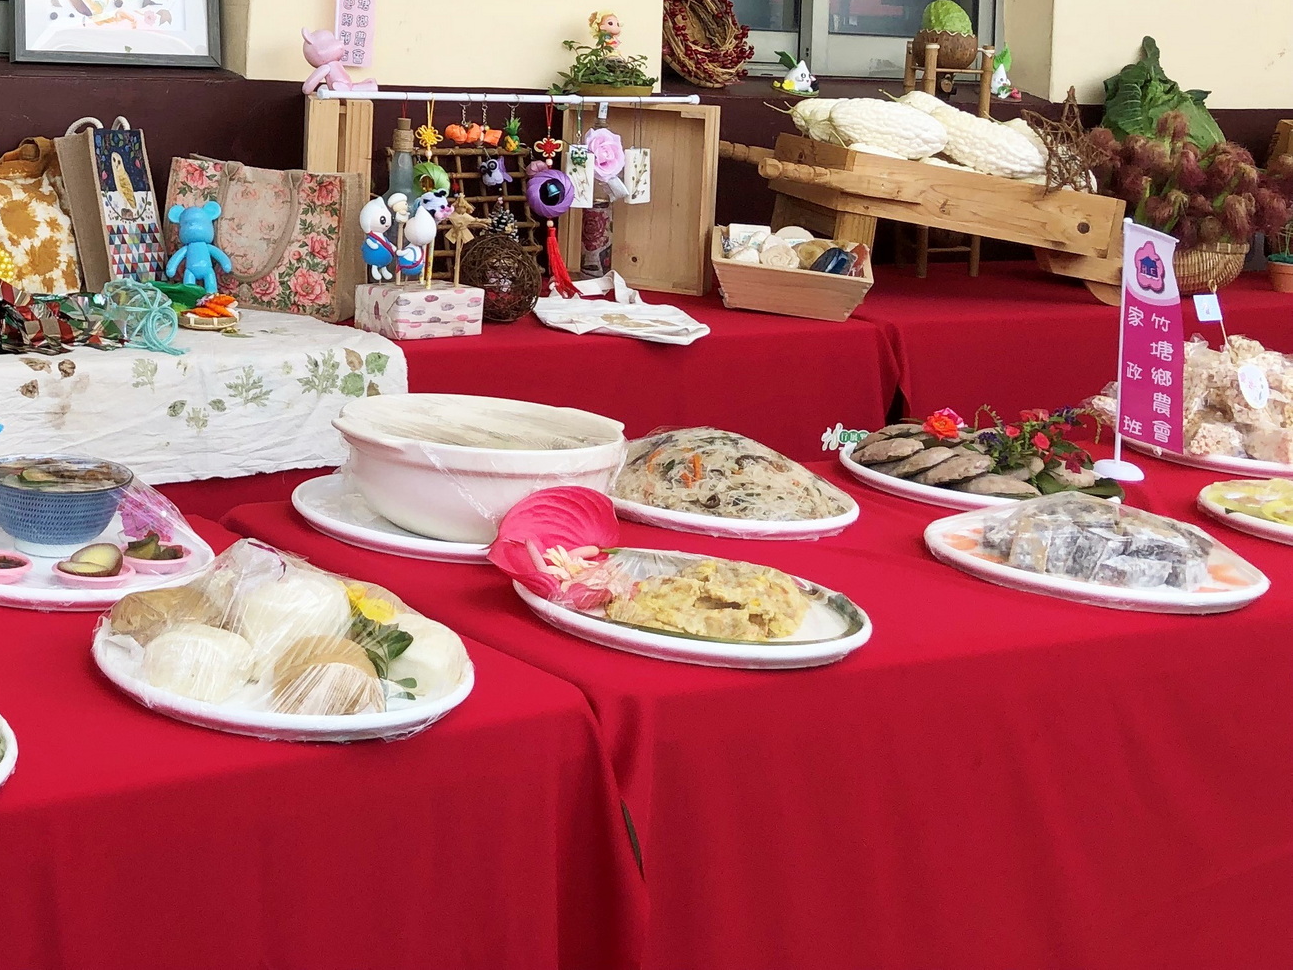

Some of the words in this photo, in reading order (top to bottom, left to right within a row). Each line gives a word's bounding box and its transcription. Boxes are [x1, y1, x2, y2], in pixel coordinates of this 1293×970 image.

[1123, 306, 1144, 436] 家政班
[1150, 312, 1174, 444] 竹塘鄉農會
